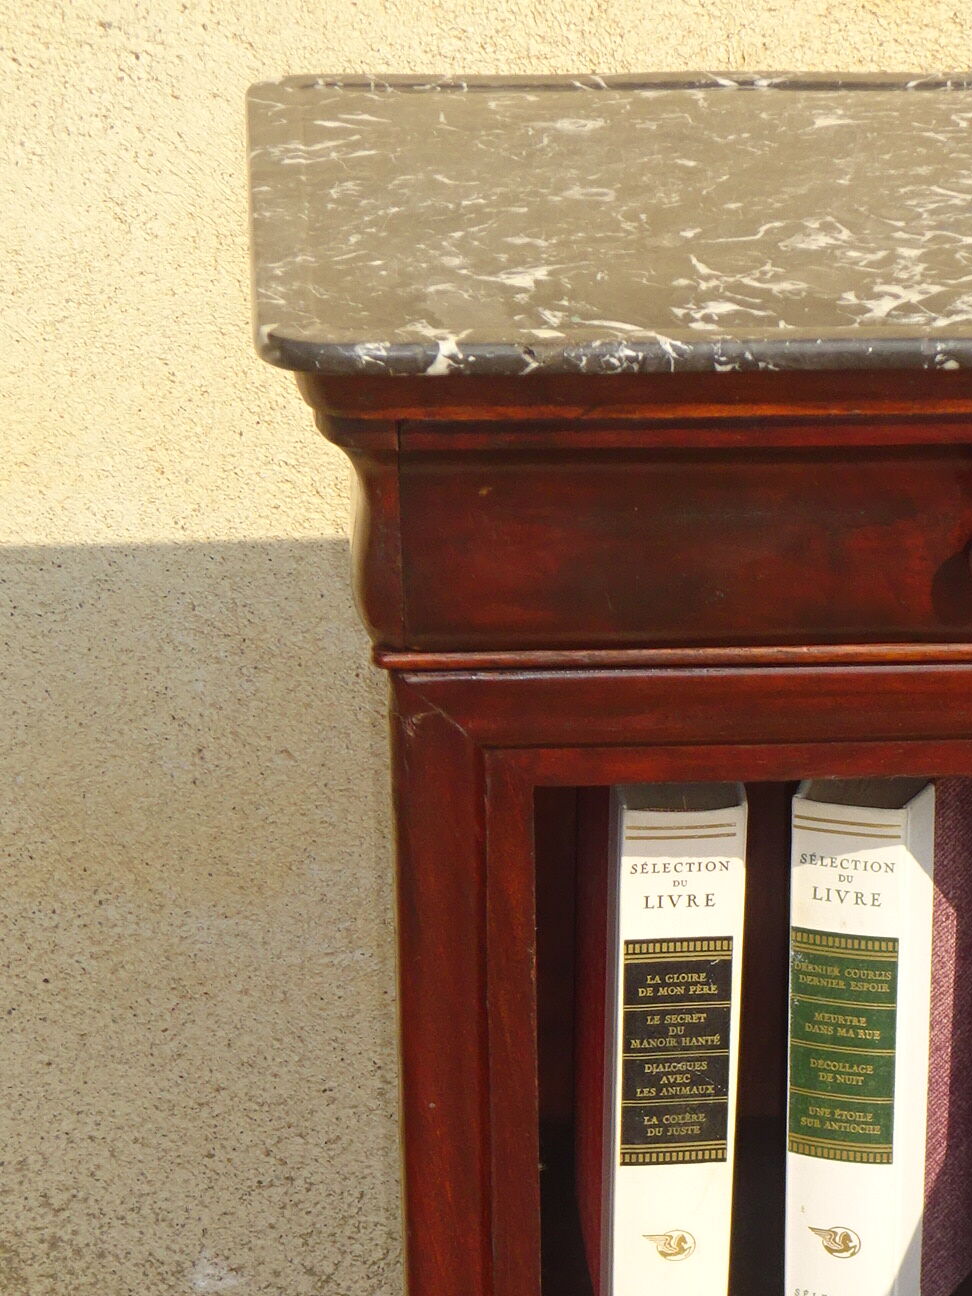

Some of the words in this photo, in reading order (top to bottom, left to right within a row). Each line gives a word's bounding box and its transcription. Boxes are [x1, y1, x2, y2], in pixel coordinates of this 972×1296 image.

[630, 861, 730, 875] SÉLECTION
[800, 852, 896, 873] SÉLECTION
[838, 874, 854, 884] DU
[644, 893, 716, 909] LIVRE
[812, 886, 882, 907] LIVRE
[794, 961, 840, 976] DERNIER
[845, 968, 892, 981] COURLIS
[646, 975, 661, 984] LA
[665, 973, 707, 983] GLOIRE
[799, 975, 846, 989] DERNIER
[850, 982, 890, 992] ESPOIR
[638, 988, 653, 996] DE
[657, 986, 685, 996] MON
[689, 984, 718, 994] PÈRE
[646, 1015, 660, 1024] LE
[664, 1013, 707, 1024] SECRET
[814, 1012, 867, 1027] MEURTRE
[668, 1027, 685, 1035] DU
[805, 1023, 834, 1035] DANS
[837, 1027, 855, 1038] MA
[858, 1029, 881, 1040] RUE
[630, 1038, 678, 1048] MANOIR
[681, 1034, 720, 1046] HANTÉ
[644, 1061, 708, 1073] DIALOGUES
[809, 1058, 874, 1074] DÉCOLLAGE
[660, 1074, 691, 1084] AVEC
[819, 1072, 833, 1082] DE
[836, 1074, 864, 1085] NUIT
[636, 1087, 656, 1097] LES
[659, 1085, 715, 1096] ANIMAUX
[643, 1116, 659, 1125] LA
[662, 1113, 706, 1124] COLÈRE
[808, 1106, 831, 1117] UNE
[834, 1106, 873, 1122] ÉTOILE
[647, 1127, 663, 1136] DU
[667, 1126, 701, 1136] JUSTE
[800, 1117, 820, 1128] SUR
[823, 1121, 881, 1134] ANTIOCHE
